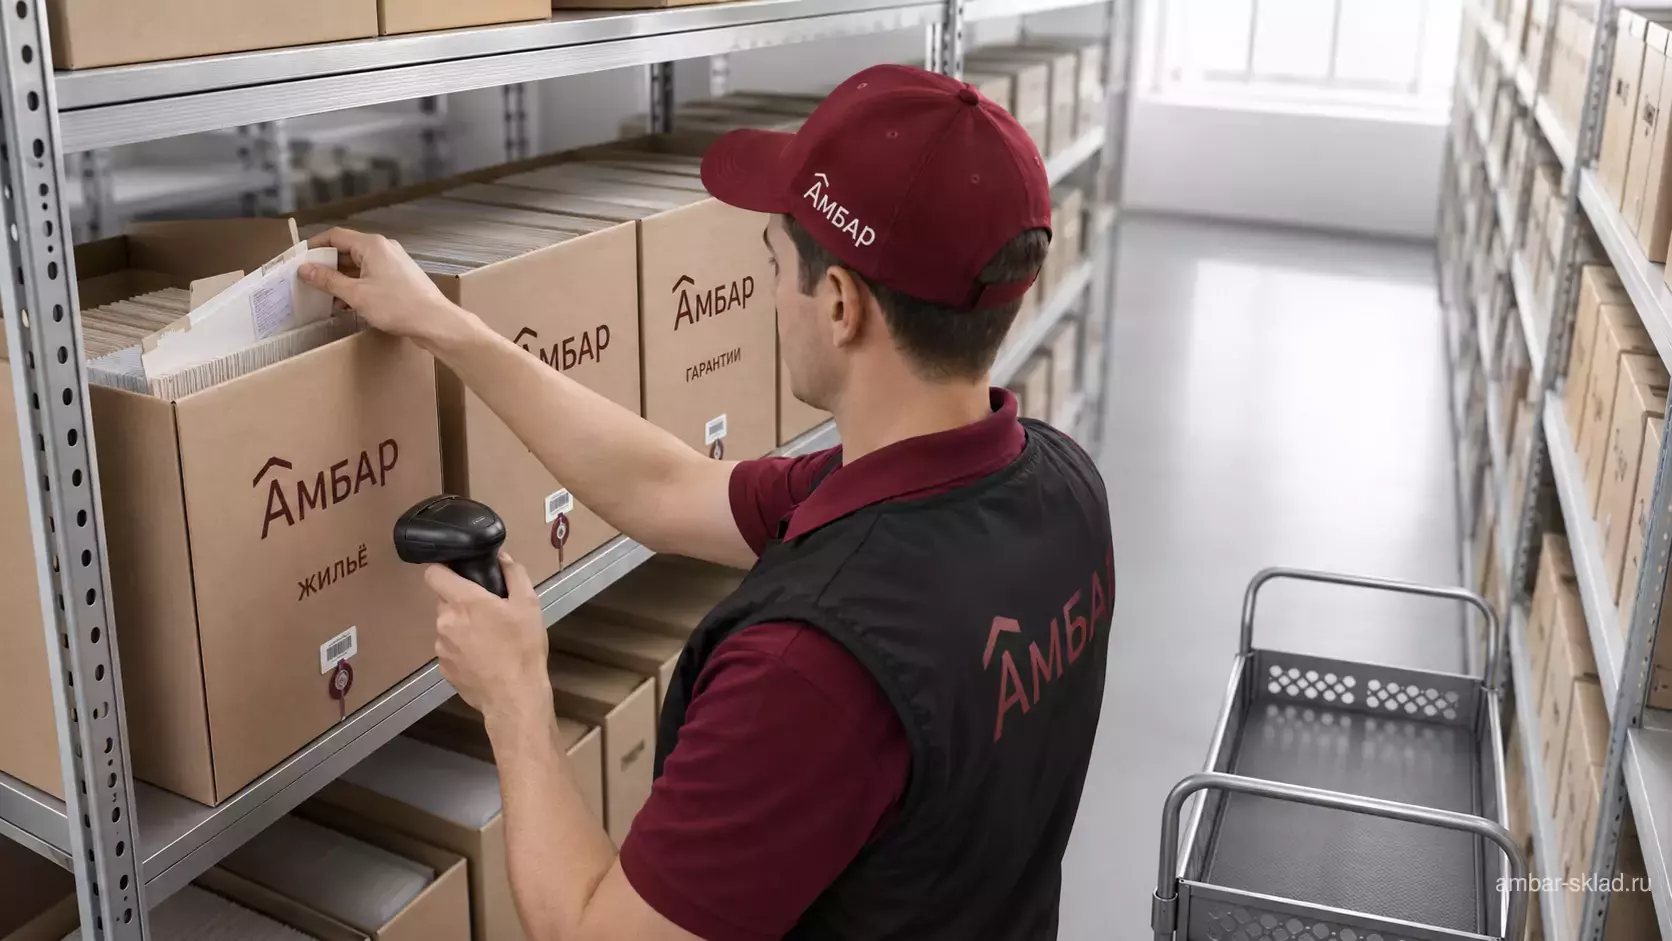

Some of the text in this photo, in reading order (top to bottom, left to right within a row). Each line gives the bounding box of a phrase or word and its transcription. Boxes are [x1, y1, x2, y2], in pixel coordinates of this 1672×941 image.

[519, 324, 610, 372] МБАР
[686, 347, 741, 382] ГАРАНТИИ
[297, 543, 369, 601] ЖИЛЬЁ
